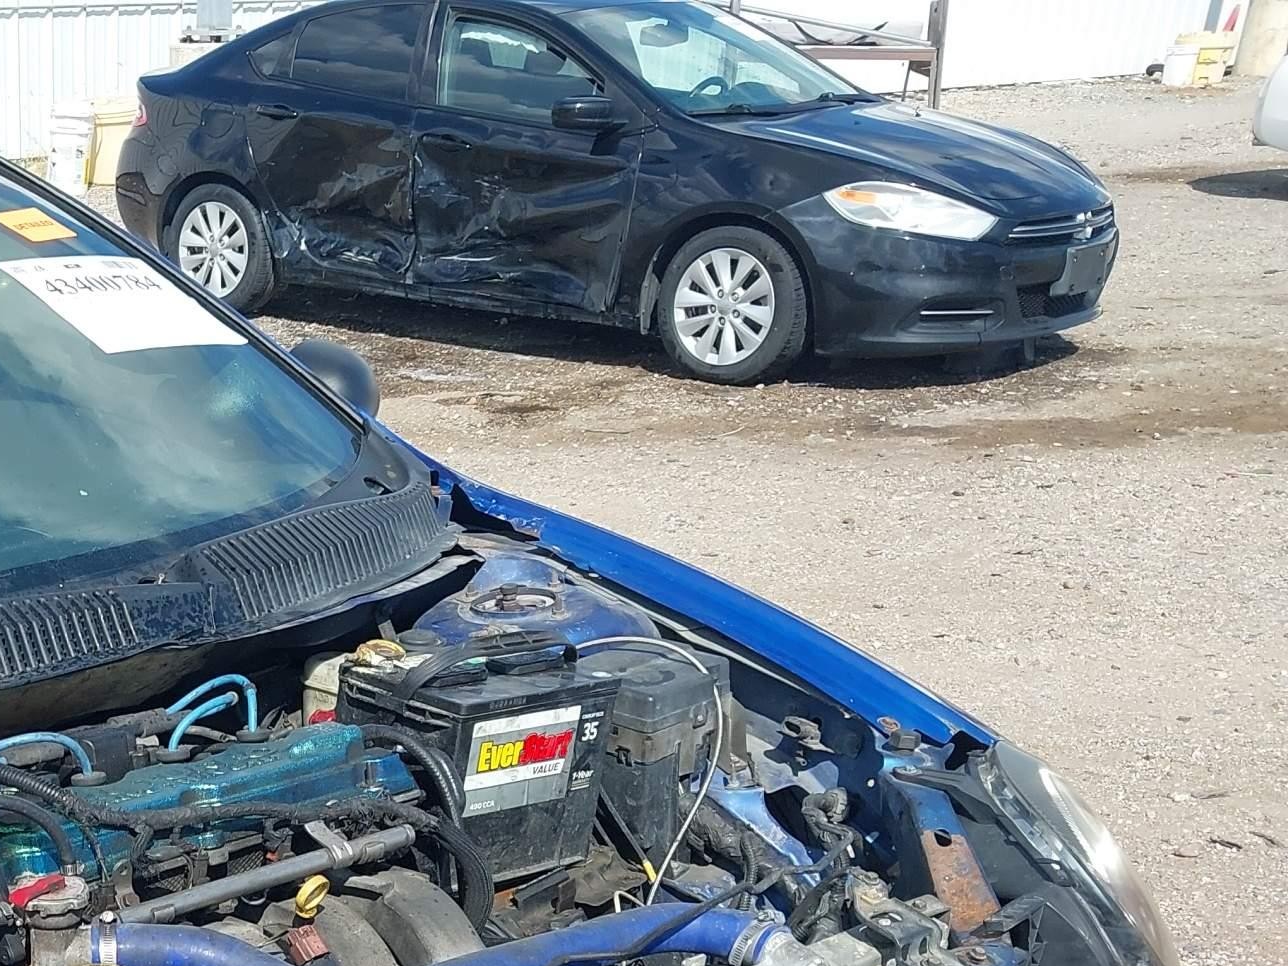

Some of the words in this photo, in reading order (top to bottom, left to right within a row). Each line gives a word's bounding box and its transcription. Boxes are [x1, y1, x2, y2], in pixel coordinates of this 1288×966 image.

[44, 273, 163, 296] 43400784
[581, 721, 600, 742] 35
[476, 728, 574, 773] EverStart
[532, 761, 561, 775] VALUE
[482, 799, 495, 809] CCA
